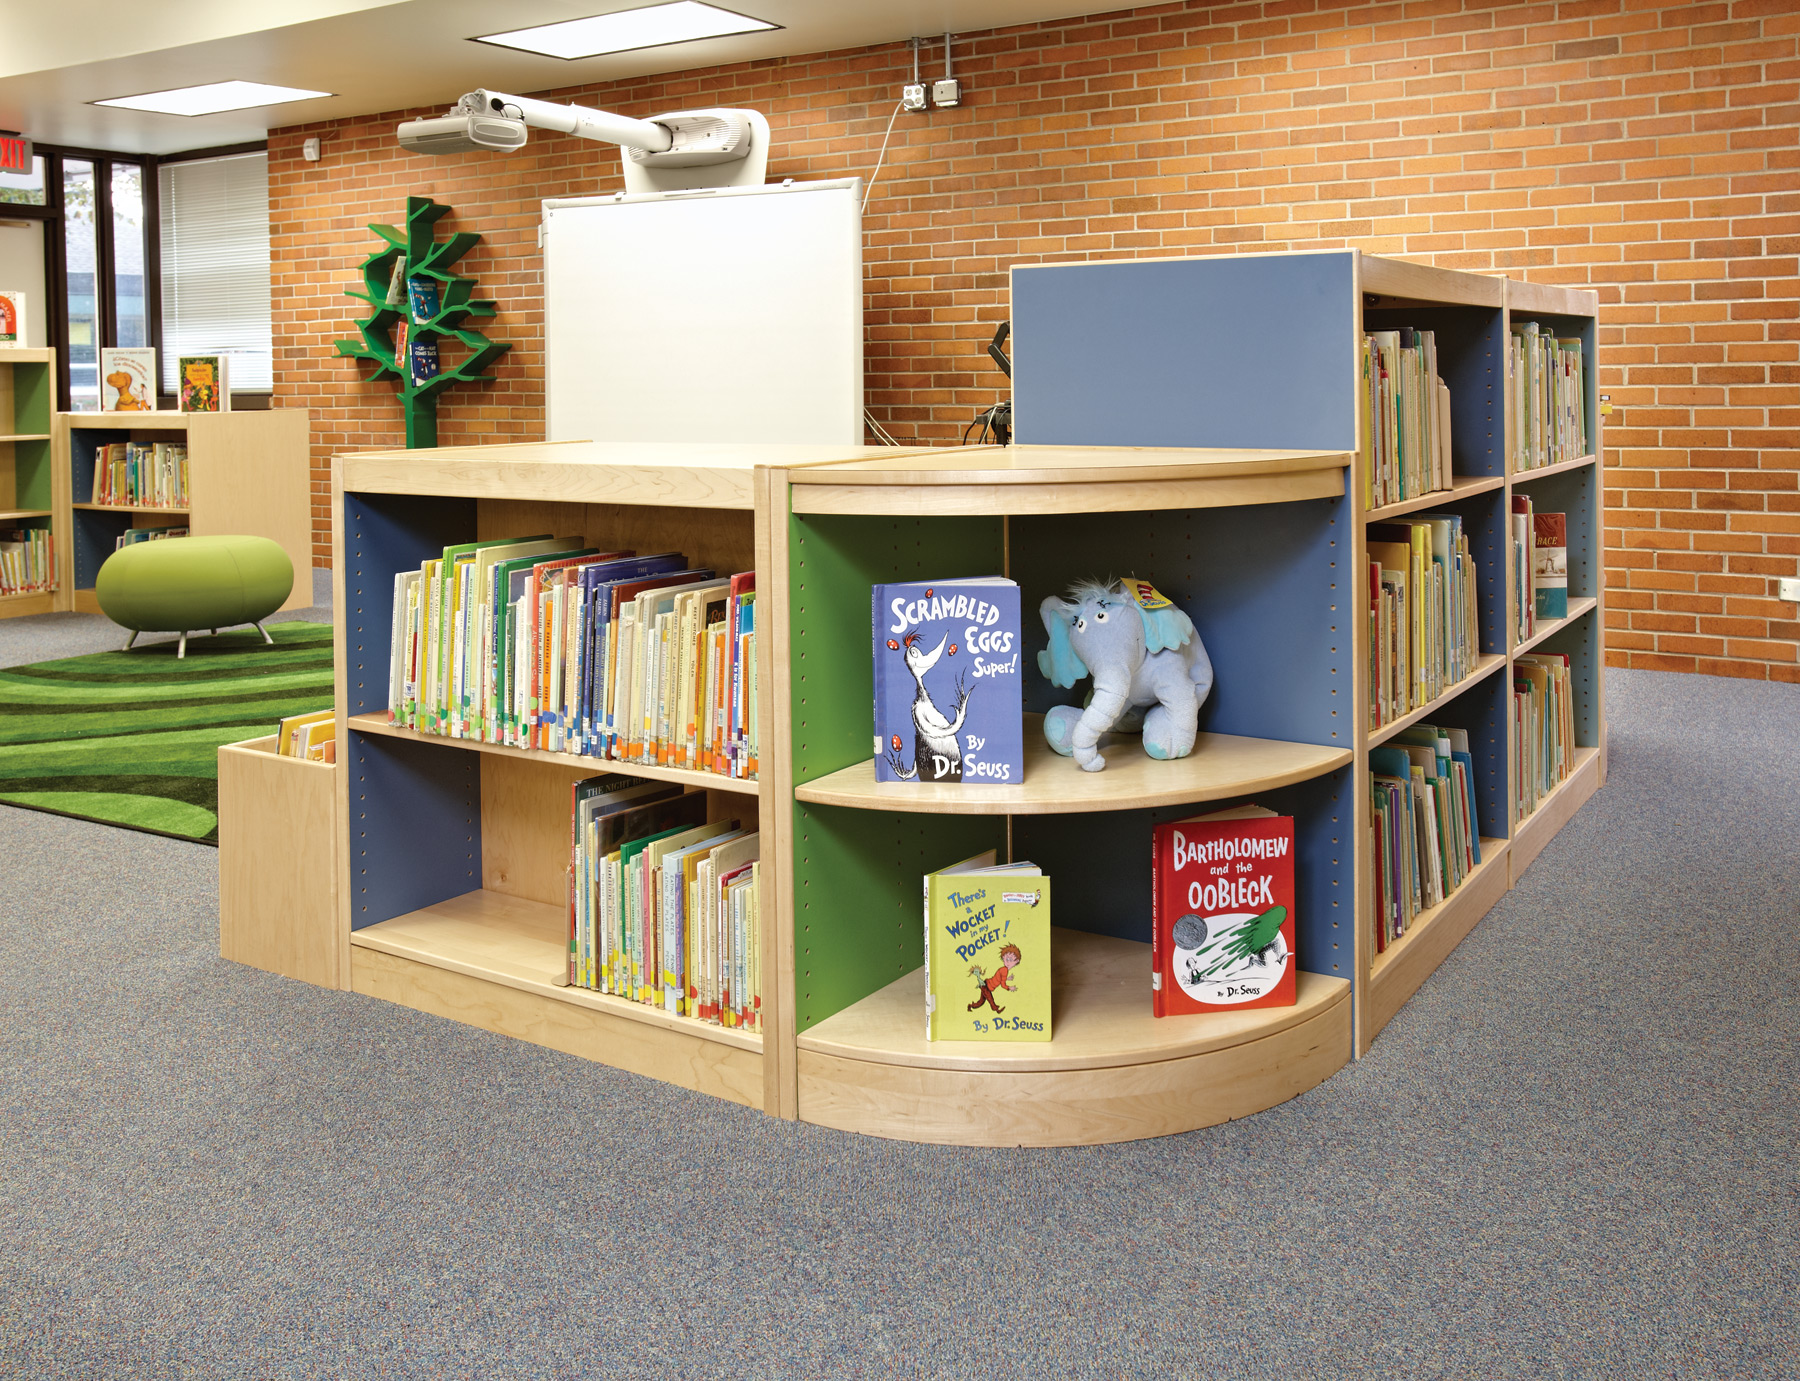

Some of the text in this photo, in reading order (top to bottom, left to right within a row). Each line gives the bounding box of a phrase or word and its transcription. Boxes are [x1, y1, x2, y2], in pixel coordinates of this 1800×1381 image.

[0, 137, 26, 169] XIT
[890, 594, 1000, 634] SCRAMBLED
[964, 626, 1015, 655] EGGS
[972, 653, 1018, 678] Super!
[966, 734, 986, 751] By
[931, 754, 1010, 780] Dr. Seuss
[586, 787, 603, 798] THE
[605, 779, 631, 793] NIGHT
[1173, 830, 1289, 872] BARTHOLOMEW
[1210, 861, 1253, 876] and the
[947, 888, 987, 909] There's
[1188, 875, 1274, 911] OOBLECK
[945, 904, 996, 939] WOCKET
[965, 906, 973, 914] a
[970, 923, 989, 938] in my
[1226, 986, 1240, 997] Dr.
[1240, 984, 1260, 996] Seuss
[973, 1016, 1044, 1033] By Dr. Seuss
